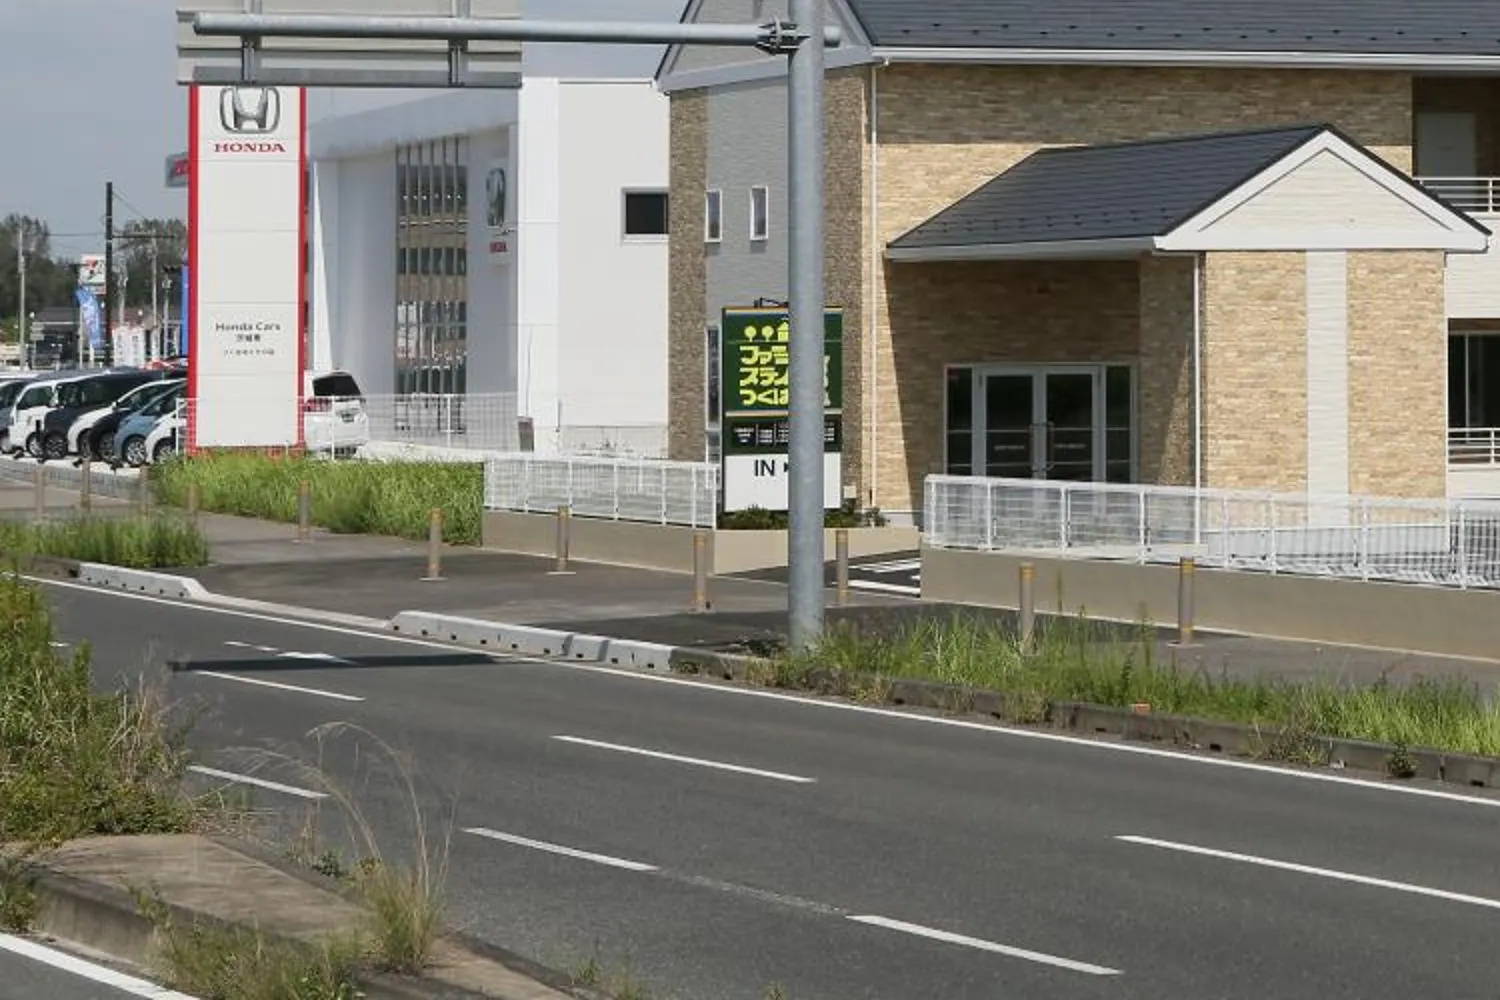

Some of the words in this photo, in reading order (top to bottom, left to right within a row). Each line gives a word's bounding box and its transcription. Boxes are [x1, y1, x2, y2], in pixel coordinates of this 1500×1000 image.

[213, 143, 286, 153] HONDA
[215, 322, 253, 332] Honda
[255, 322, 281, 331] Cars
[754, 459, 775, 477] IN
